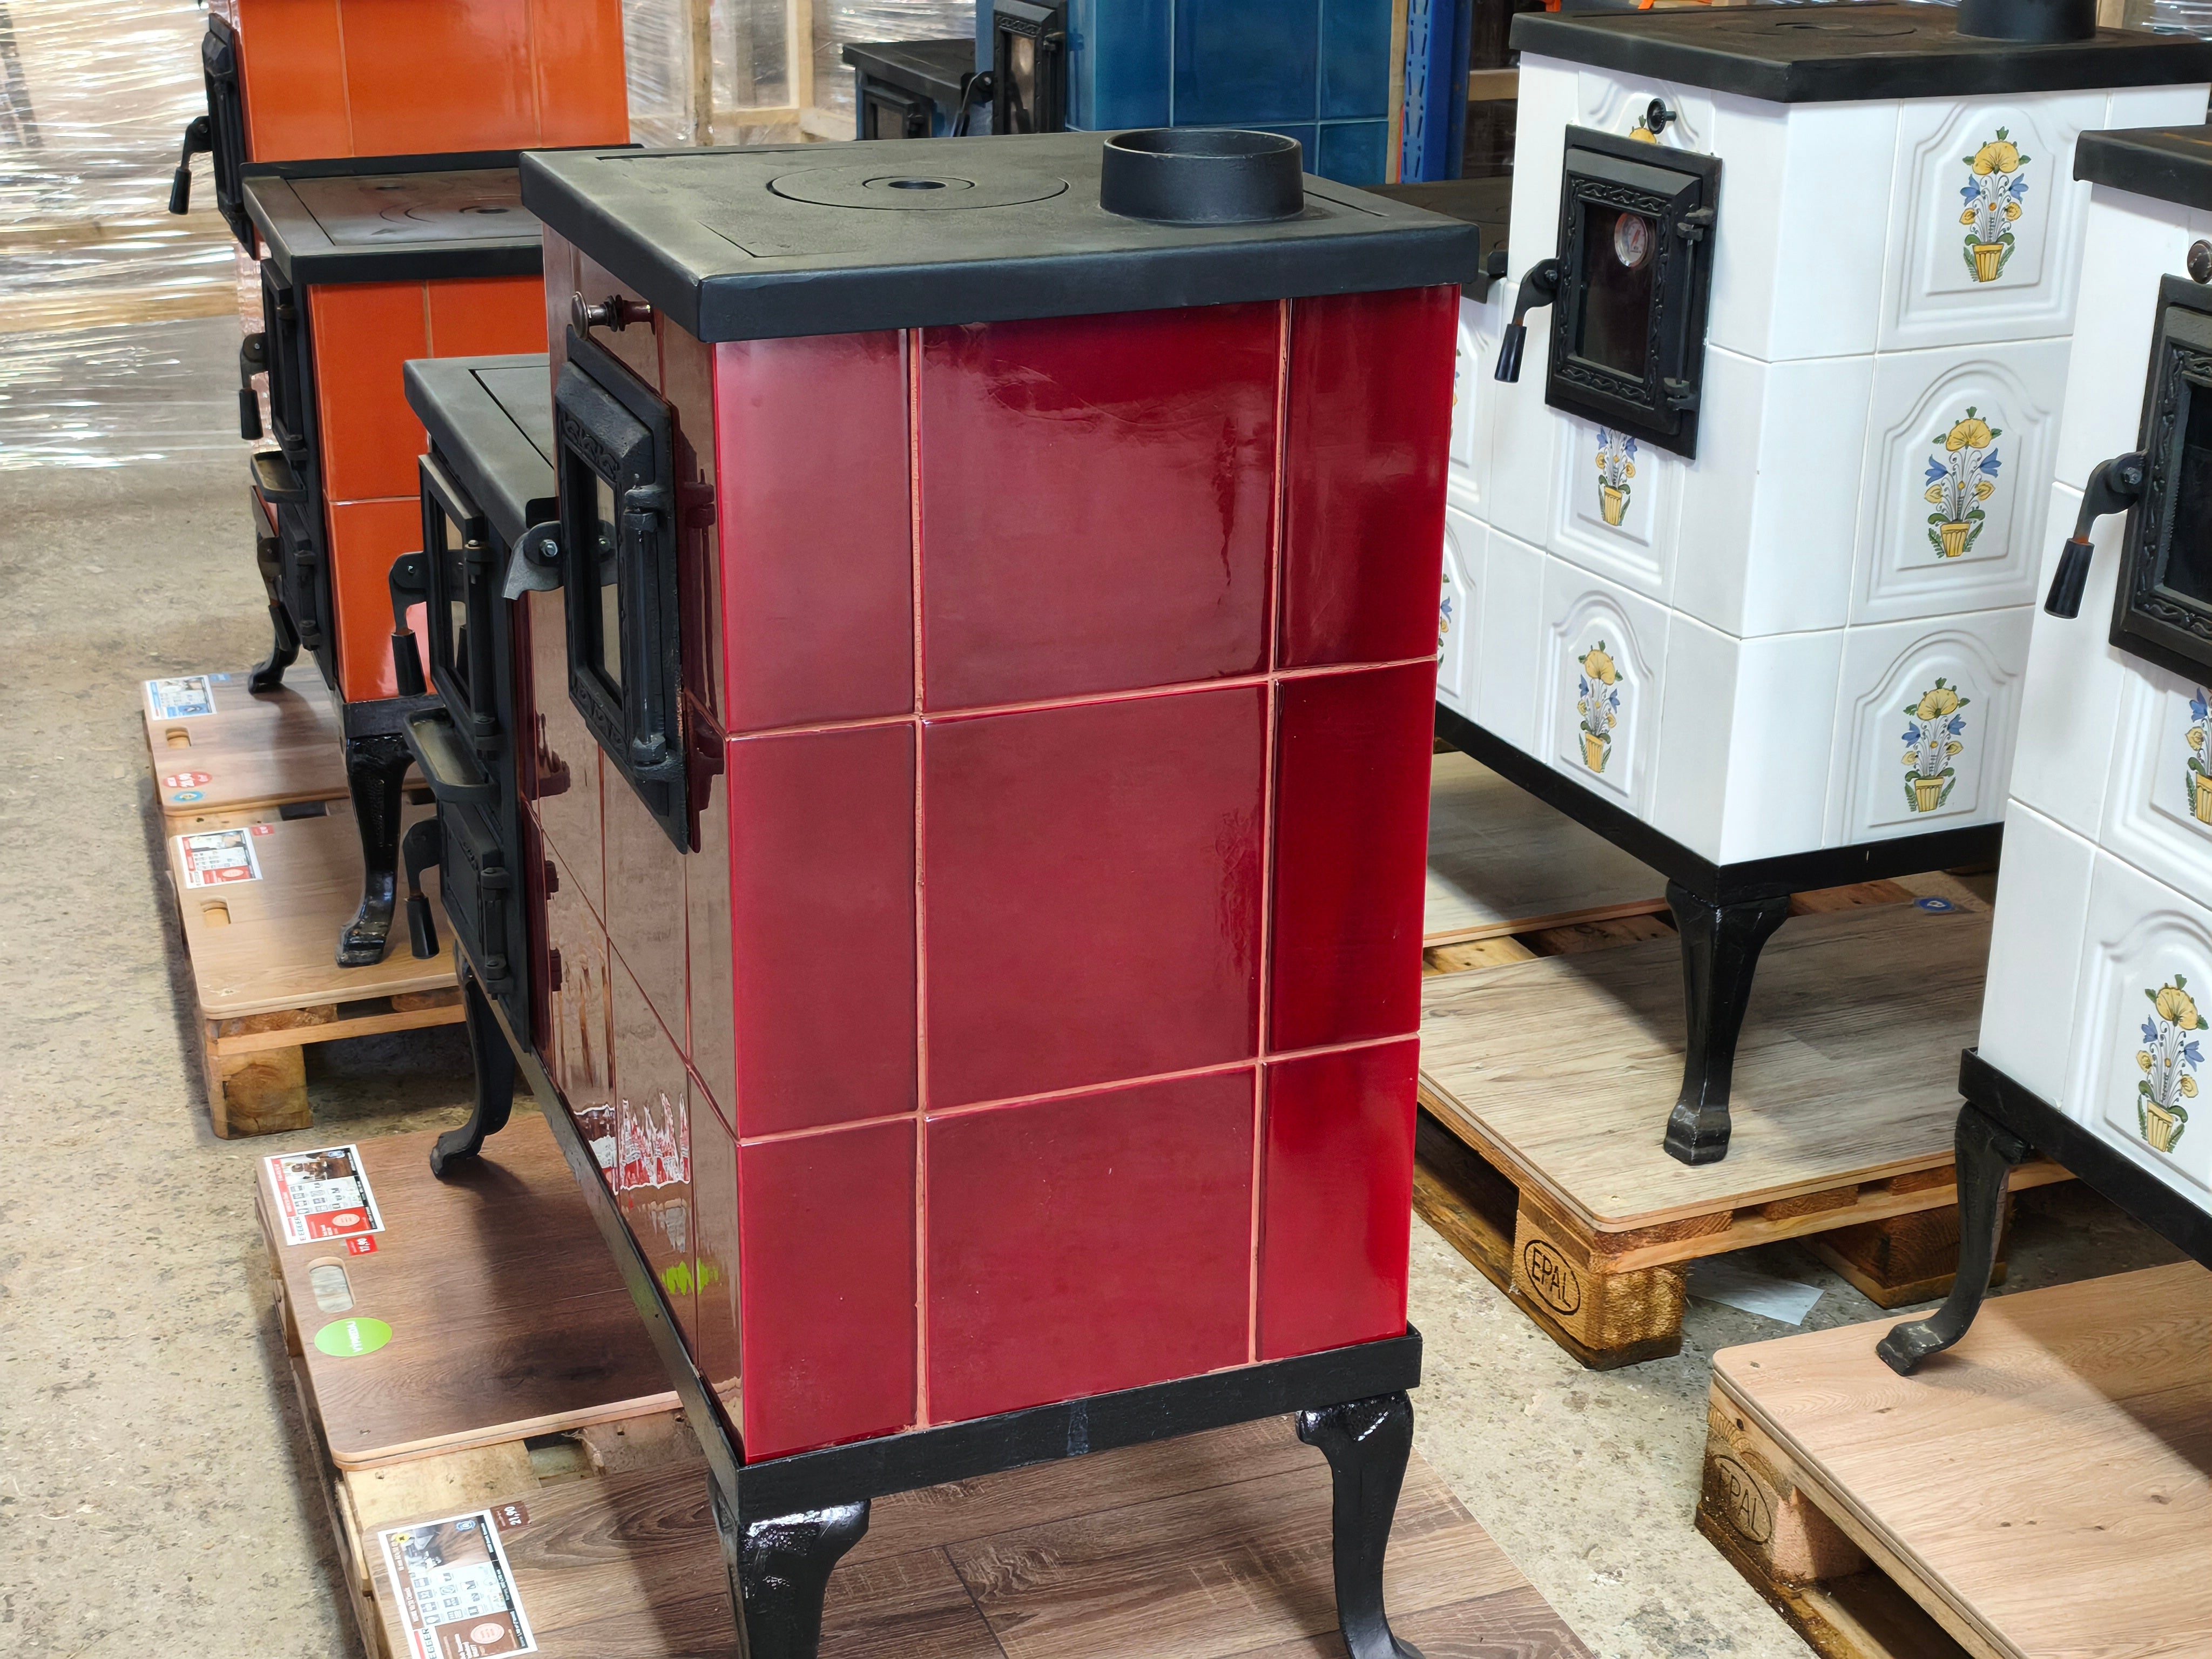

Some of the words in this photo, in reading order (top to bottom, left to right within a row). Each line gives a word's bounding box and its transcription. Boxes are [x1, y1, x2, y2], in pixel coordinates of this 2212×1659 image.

[293, 1216, 305, 1236] EGGER
[356, 1238, 371, 1252] 17,90
[1532, 1246, 1572, 1309] EPAL
[503, 1506, 523, 1526] 21,90
[421, 1627, 437, 1659] EGGER
